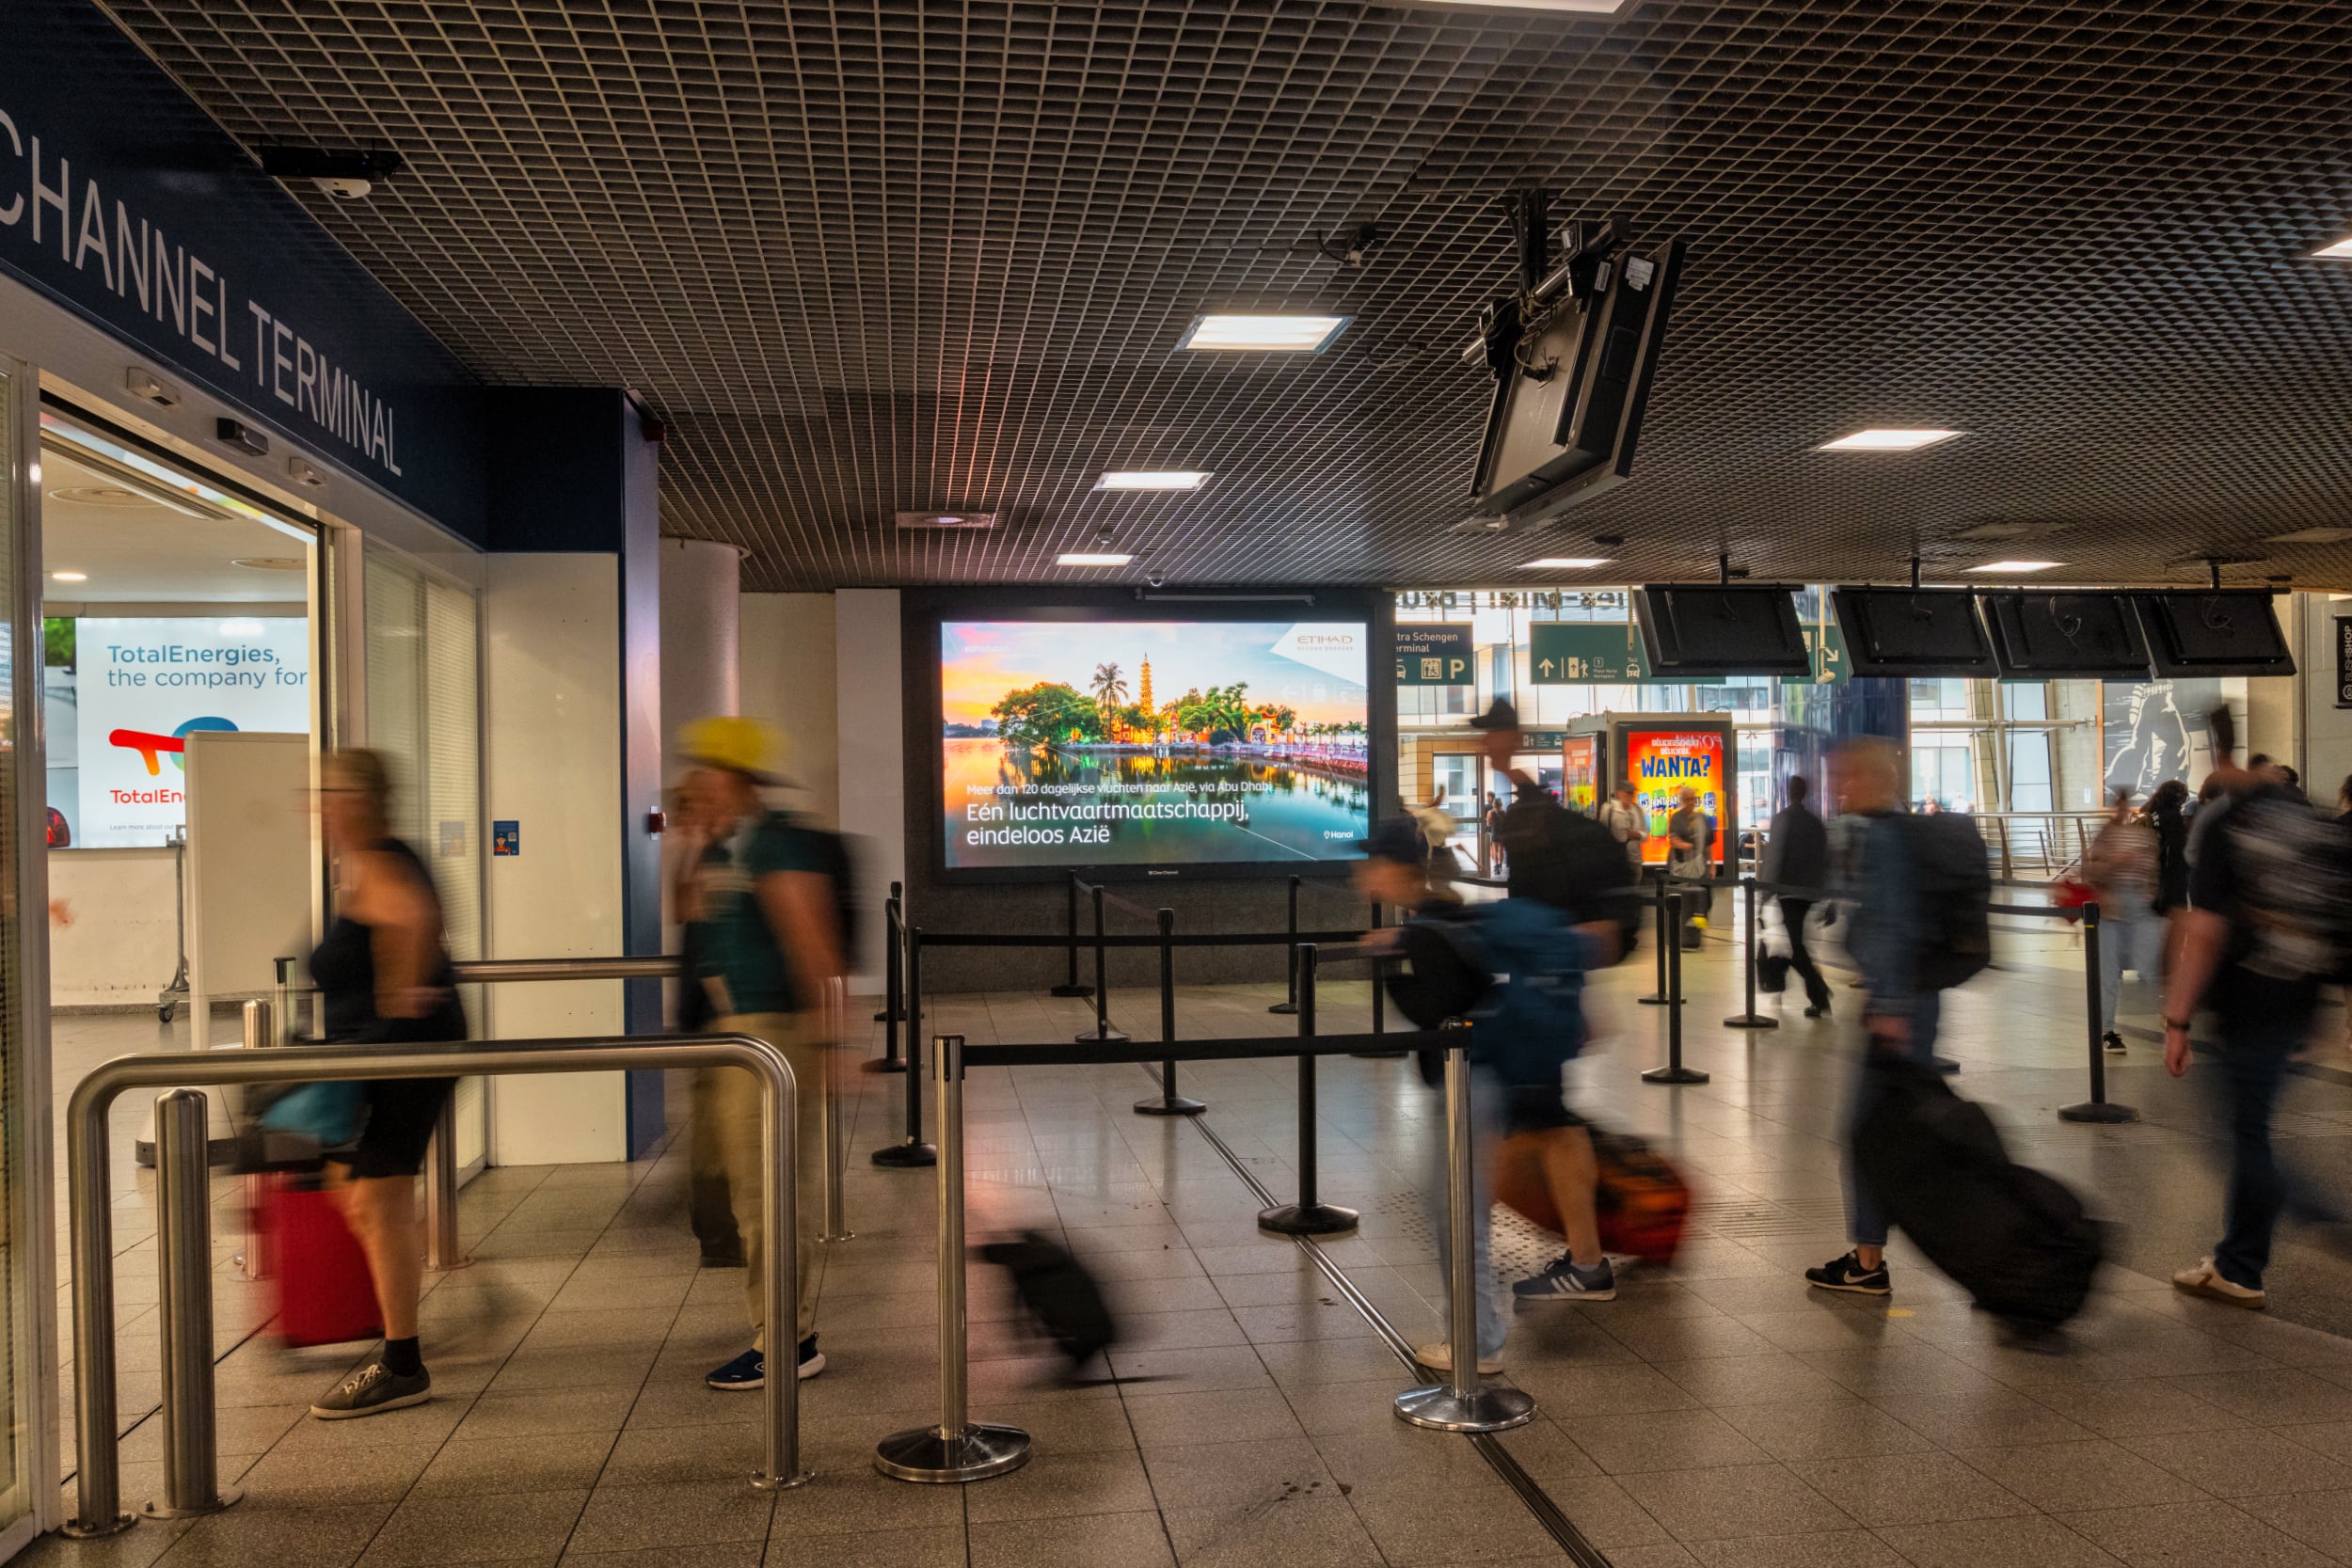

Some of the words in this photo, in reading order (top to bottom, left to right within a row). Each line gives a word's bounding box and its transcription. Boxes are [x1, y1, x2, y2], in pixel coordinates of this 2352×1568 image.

[0, 108, 240, 371] CHANNEL
[248, 299, 402, 477] TERMINAL
[1296, 635, 1354, 644] ETIHAD
[1412, 632, 1458, 643] Schengen
[106, 644, 280, 666] TotalEnergies,
[107, 668, 147, 687] the
[154, 671, 267, 689] company
[274, 667, 309, 686] for
[1641, 755, 1711, 778] WANTA?
[966, 784, 994, 796] Meer
[996, 784, 1018, 795] dan
[1022, 784, 1039, 795] 120
[1041, 782, 1095, 797] dagelijkse
[1097, 782, 1143, 795] vluchten
[1146, 784, 1171, 794] naar
[1173, 782, 1198, 794] Azië,
[1199, 782, 1216, 792] via
[1217, 781, 1238, 792] Abu
[1240, 781, 1273, 792] Dhabi
[967, 802, 1003, 821] Eén
[1009, 800, 1249, 822] luchtvaartmaatschappij,
[966, 825, 1064, 845] eindeloos
[1069, 824, 1110, 843] Azië
[1330, 830, 1354, 839] Hanoi
